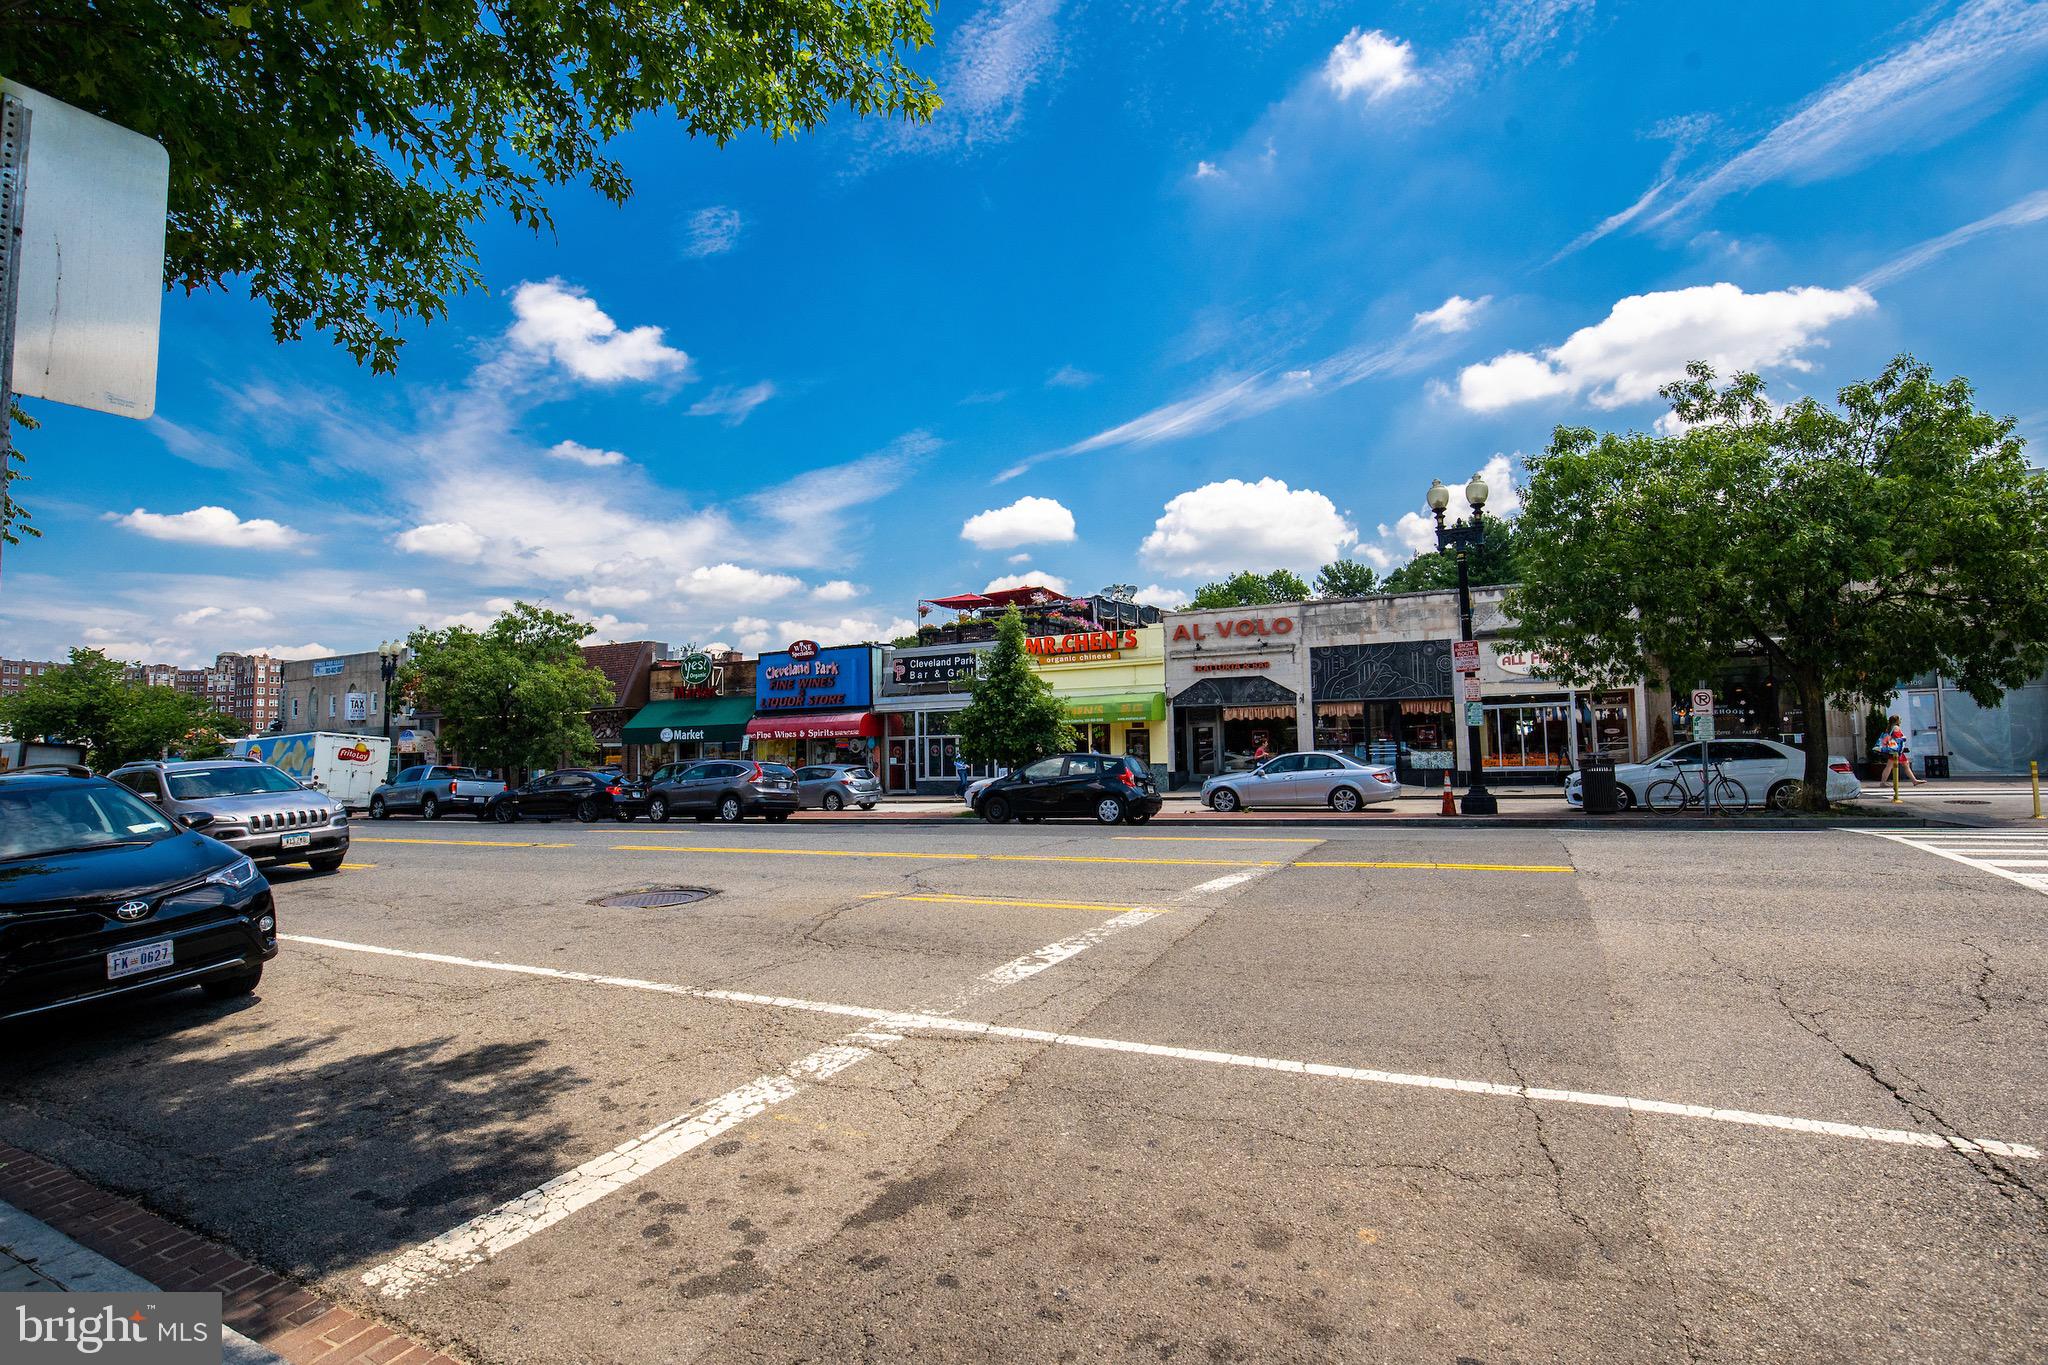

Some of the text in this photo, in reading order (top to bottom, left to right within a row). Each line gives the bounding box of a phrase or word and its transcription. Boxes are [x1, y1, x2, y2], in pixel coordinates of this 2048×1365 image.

[1173, 617, 1293, 641] AL VOLO
[794, 642, 812, 651] WINE
[910, 658, 951, 669] Cleveland
[954, 656, 974, 666] Park
[1046, 653, 1112, 664] organic chinese
[1502, 655, 1526, 666] ALL
[684, 659, 707, 680] yes!
[766, 660, 840, 680] Cleveland Park
[909, 667, 974, 680] Bar & Grll
[769, 677, 836, 691] FINE WINES
[351, 700, 365, 709] TAX
[760, 694, 846, 708] LIQUOR STORE
[674, 729, 704, 740] Market
[757, 731, 772, 741] Fine
[775, 730, 798, 739] Wines
[800, 730, 805, 738] &
[808, 729, 834, 738] Spirits
[114, 948, 168, 971] FK 0627
